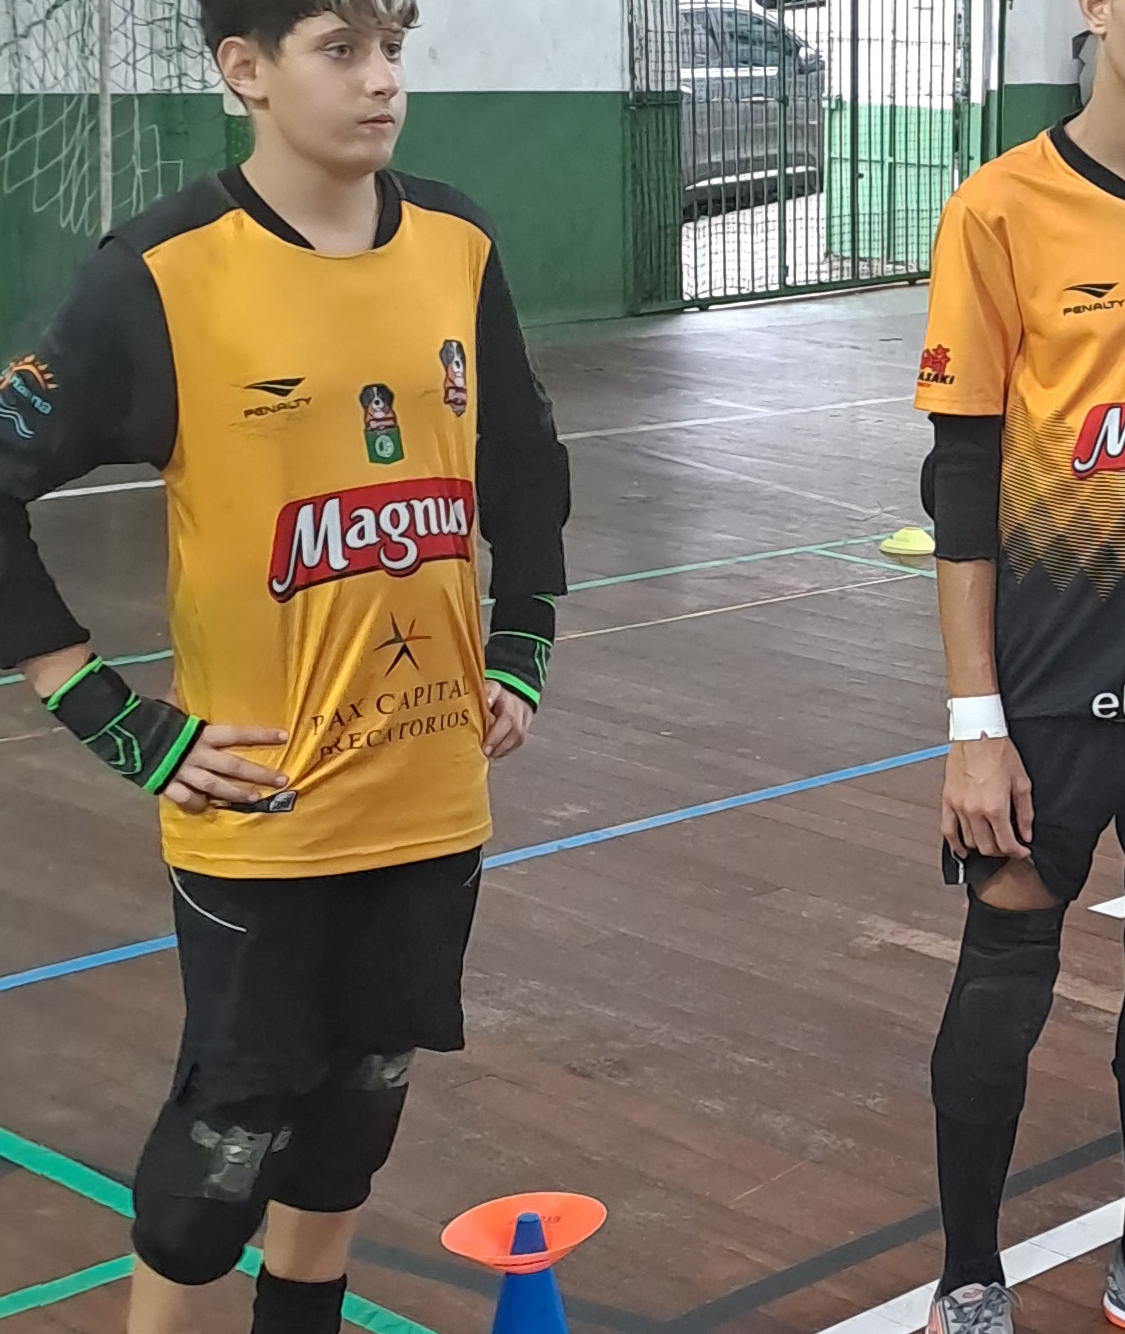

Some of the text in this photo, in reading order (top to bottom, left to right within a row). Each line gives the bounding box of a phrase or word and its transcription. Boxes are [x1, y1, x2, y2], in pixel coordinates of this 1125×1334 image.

[1062, 298, 1125, 317] PENALTY
[243, 396, 313, 419] PENALTY
[311, 675, 471, 736] PAX CAPITAL
